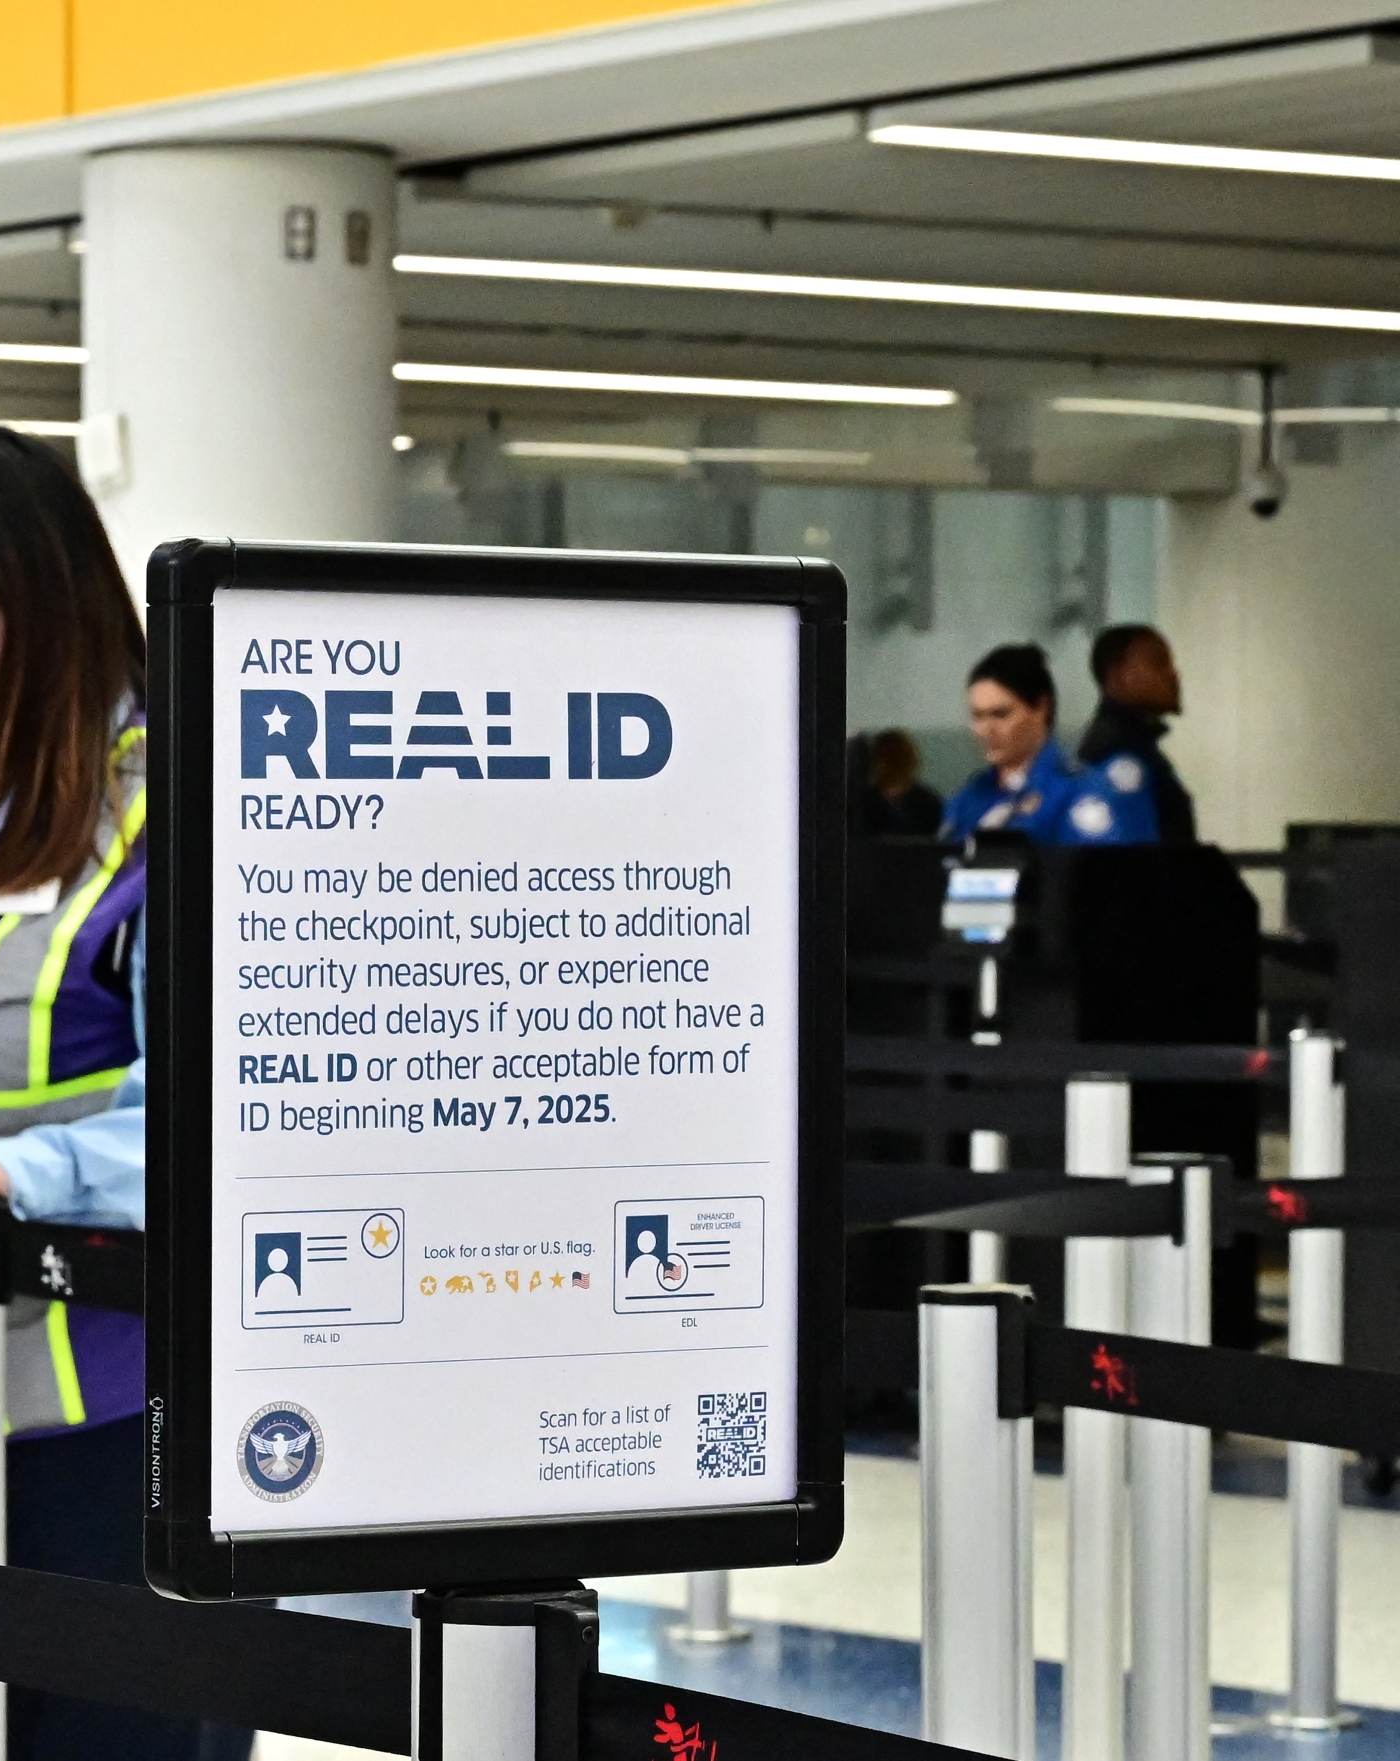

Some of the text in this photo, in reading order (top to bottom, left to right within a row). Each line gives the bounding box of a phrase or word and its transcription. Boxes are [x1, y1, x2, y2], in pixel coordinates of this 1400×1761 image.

[241, 639, 400, 675] ARE YOU
[241, 689, 672, 779] REAL ID
[242, 794, 384, 829] READY?
[238, 860, 730, 898] You may be denied access through
[238, 906, 749, 945] the checkpoint, subject to additional
[239, 953, 709, 993] security measures, or experience
[239, 999, 763, 1038] extended delays if you do not have a
[240, 1043, 750, 1084] REAL ID or other acceptable form of
[241, 1094, 616, 1135] ID beginning May 7, 2025.
[690, 1221, 741, 1231] DRIVER LICENSE
[697, 1213, 735, 1221] ENHANCED
[425, 1241, 595, 1258] Look for a star or U.S. flag.
[304, 1333, 340, 1343] REAL ID
[682, 1318, 697, 1327] EDL
[238, 1402, 323, 1460] TRANSPORTATION SECURITY
[540, 1404, 671, 1428] Scan for a list of
[539, 1431, 661, 1454] TSA acceptable
[707, 1427, 756, 1441] REAL ID
[151, 1411, 161, 1508] VISIONTRON
[540, 1459, 655, 1481] identifications
[242, 1473, 317, 1502] ADMINISTRATION
